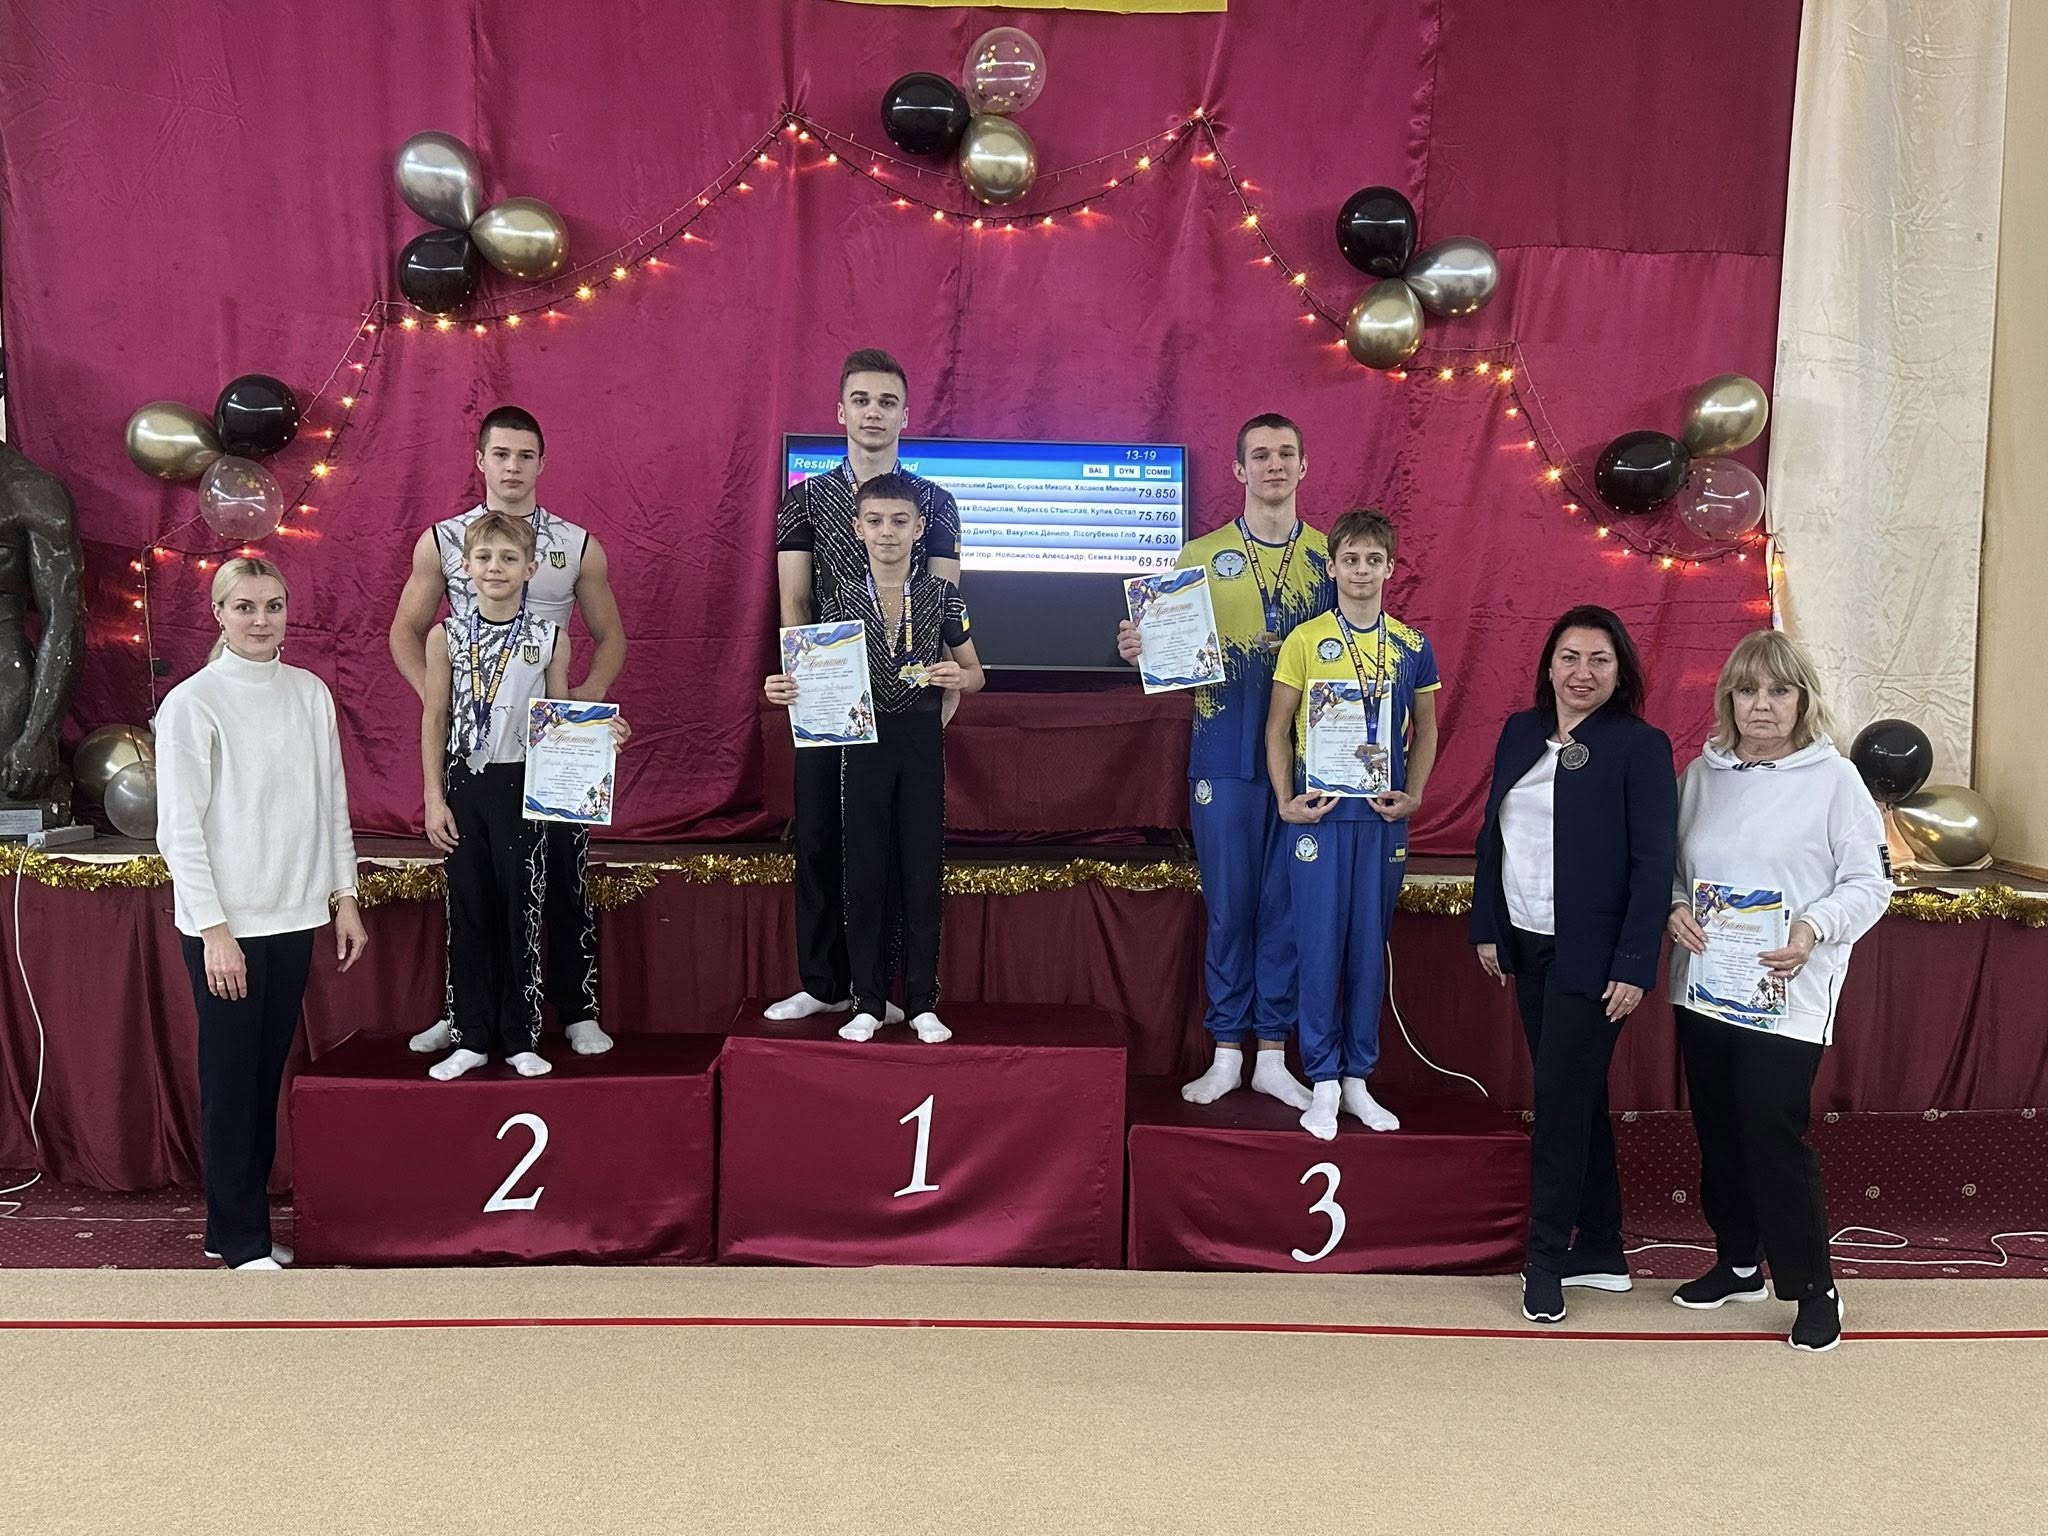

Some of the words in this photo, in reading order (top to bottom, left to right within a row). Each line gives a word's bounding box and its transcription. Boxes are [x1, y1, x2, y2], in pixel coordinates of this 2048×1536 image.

[1125, 449, 1157, 461] 13-19
[1146, 468, 1170, 476] COMBI
[1138, 488, 1176, 499] 79.850
[1138, 511, 1176, 522] 75.760
[1138, 534, 1176, 545] 74.630
[1138, 557, 1176, 568] 69.510
[893, 1093, 941, 1200] 1
[483, 1111, 552, 1214] 2
[1291, 1161, 1349, 1263] 3
